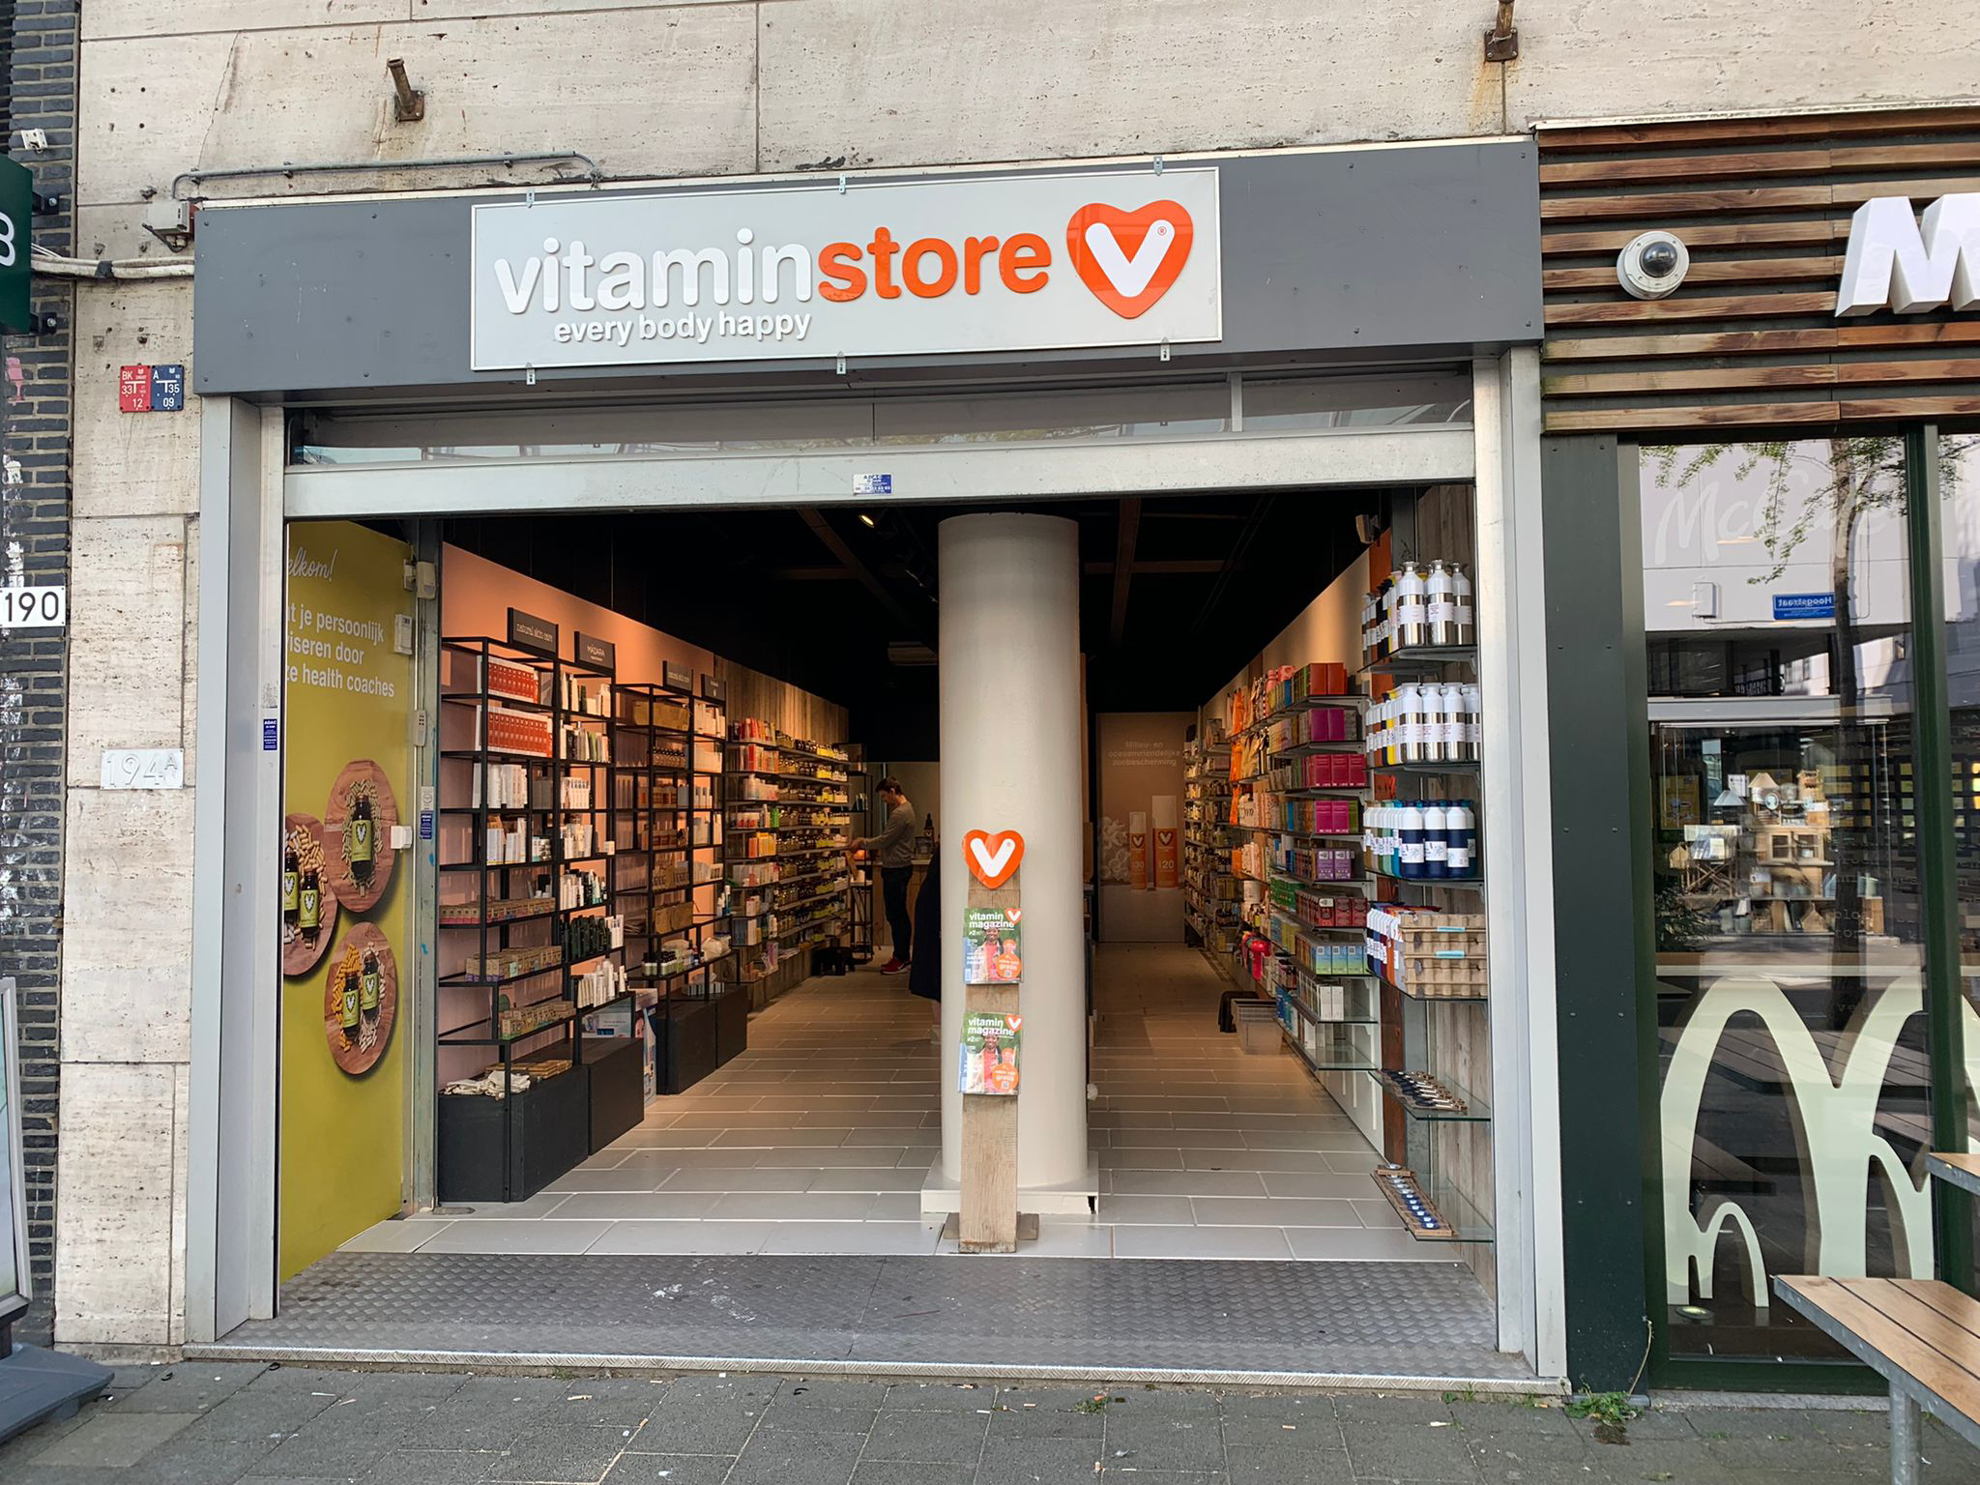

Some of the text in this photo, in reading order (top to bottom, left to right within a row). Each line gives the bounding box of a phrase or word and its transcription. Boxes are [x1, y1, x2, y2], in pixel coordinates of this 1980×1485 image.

[493, 227, 1052, 314] vitaminstore
[554, 310, 812, 347] every body happy
[122, 370, 133, 380] BK
[153, 369, 159, 380] A
[5, 591, 59, 622] 190
[299, 604, 313, 629] je
[316, 611, 385, 646] persoonlijk
[335, 641, 365, 665] door
[302, 662, 343, 689] health
[346, 674, 395, 698] coaches
[969, 912, 1004, 922] vitamin
[968, 1017, 1004, 1027] vitamin
